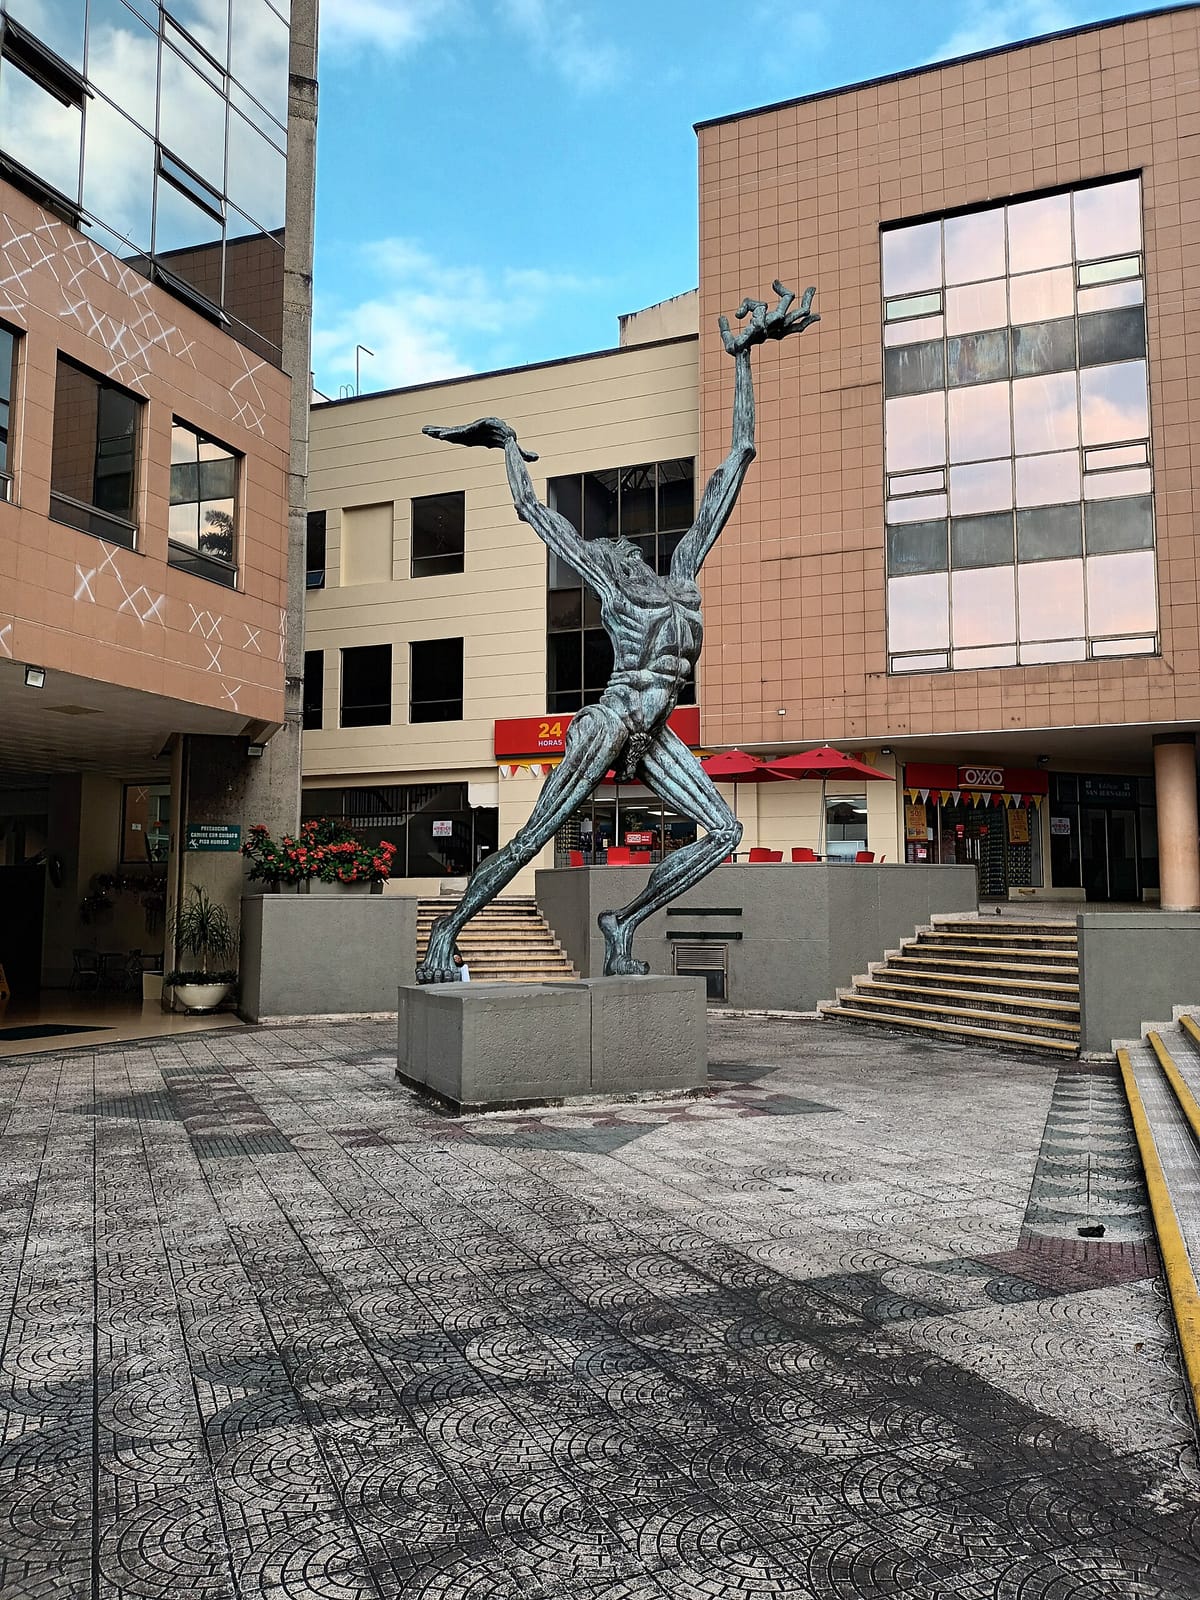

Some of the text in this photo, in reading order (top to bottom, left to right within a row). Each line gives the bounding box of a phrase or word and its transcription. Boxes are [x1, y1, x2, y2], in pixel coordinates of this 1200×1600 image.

[538, 722, 562, 738] 24
[538, 739, 563, 747] HORAS
[965, 769, 1003, 785] OXXO
